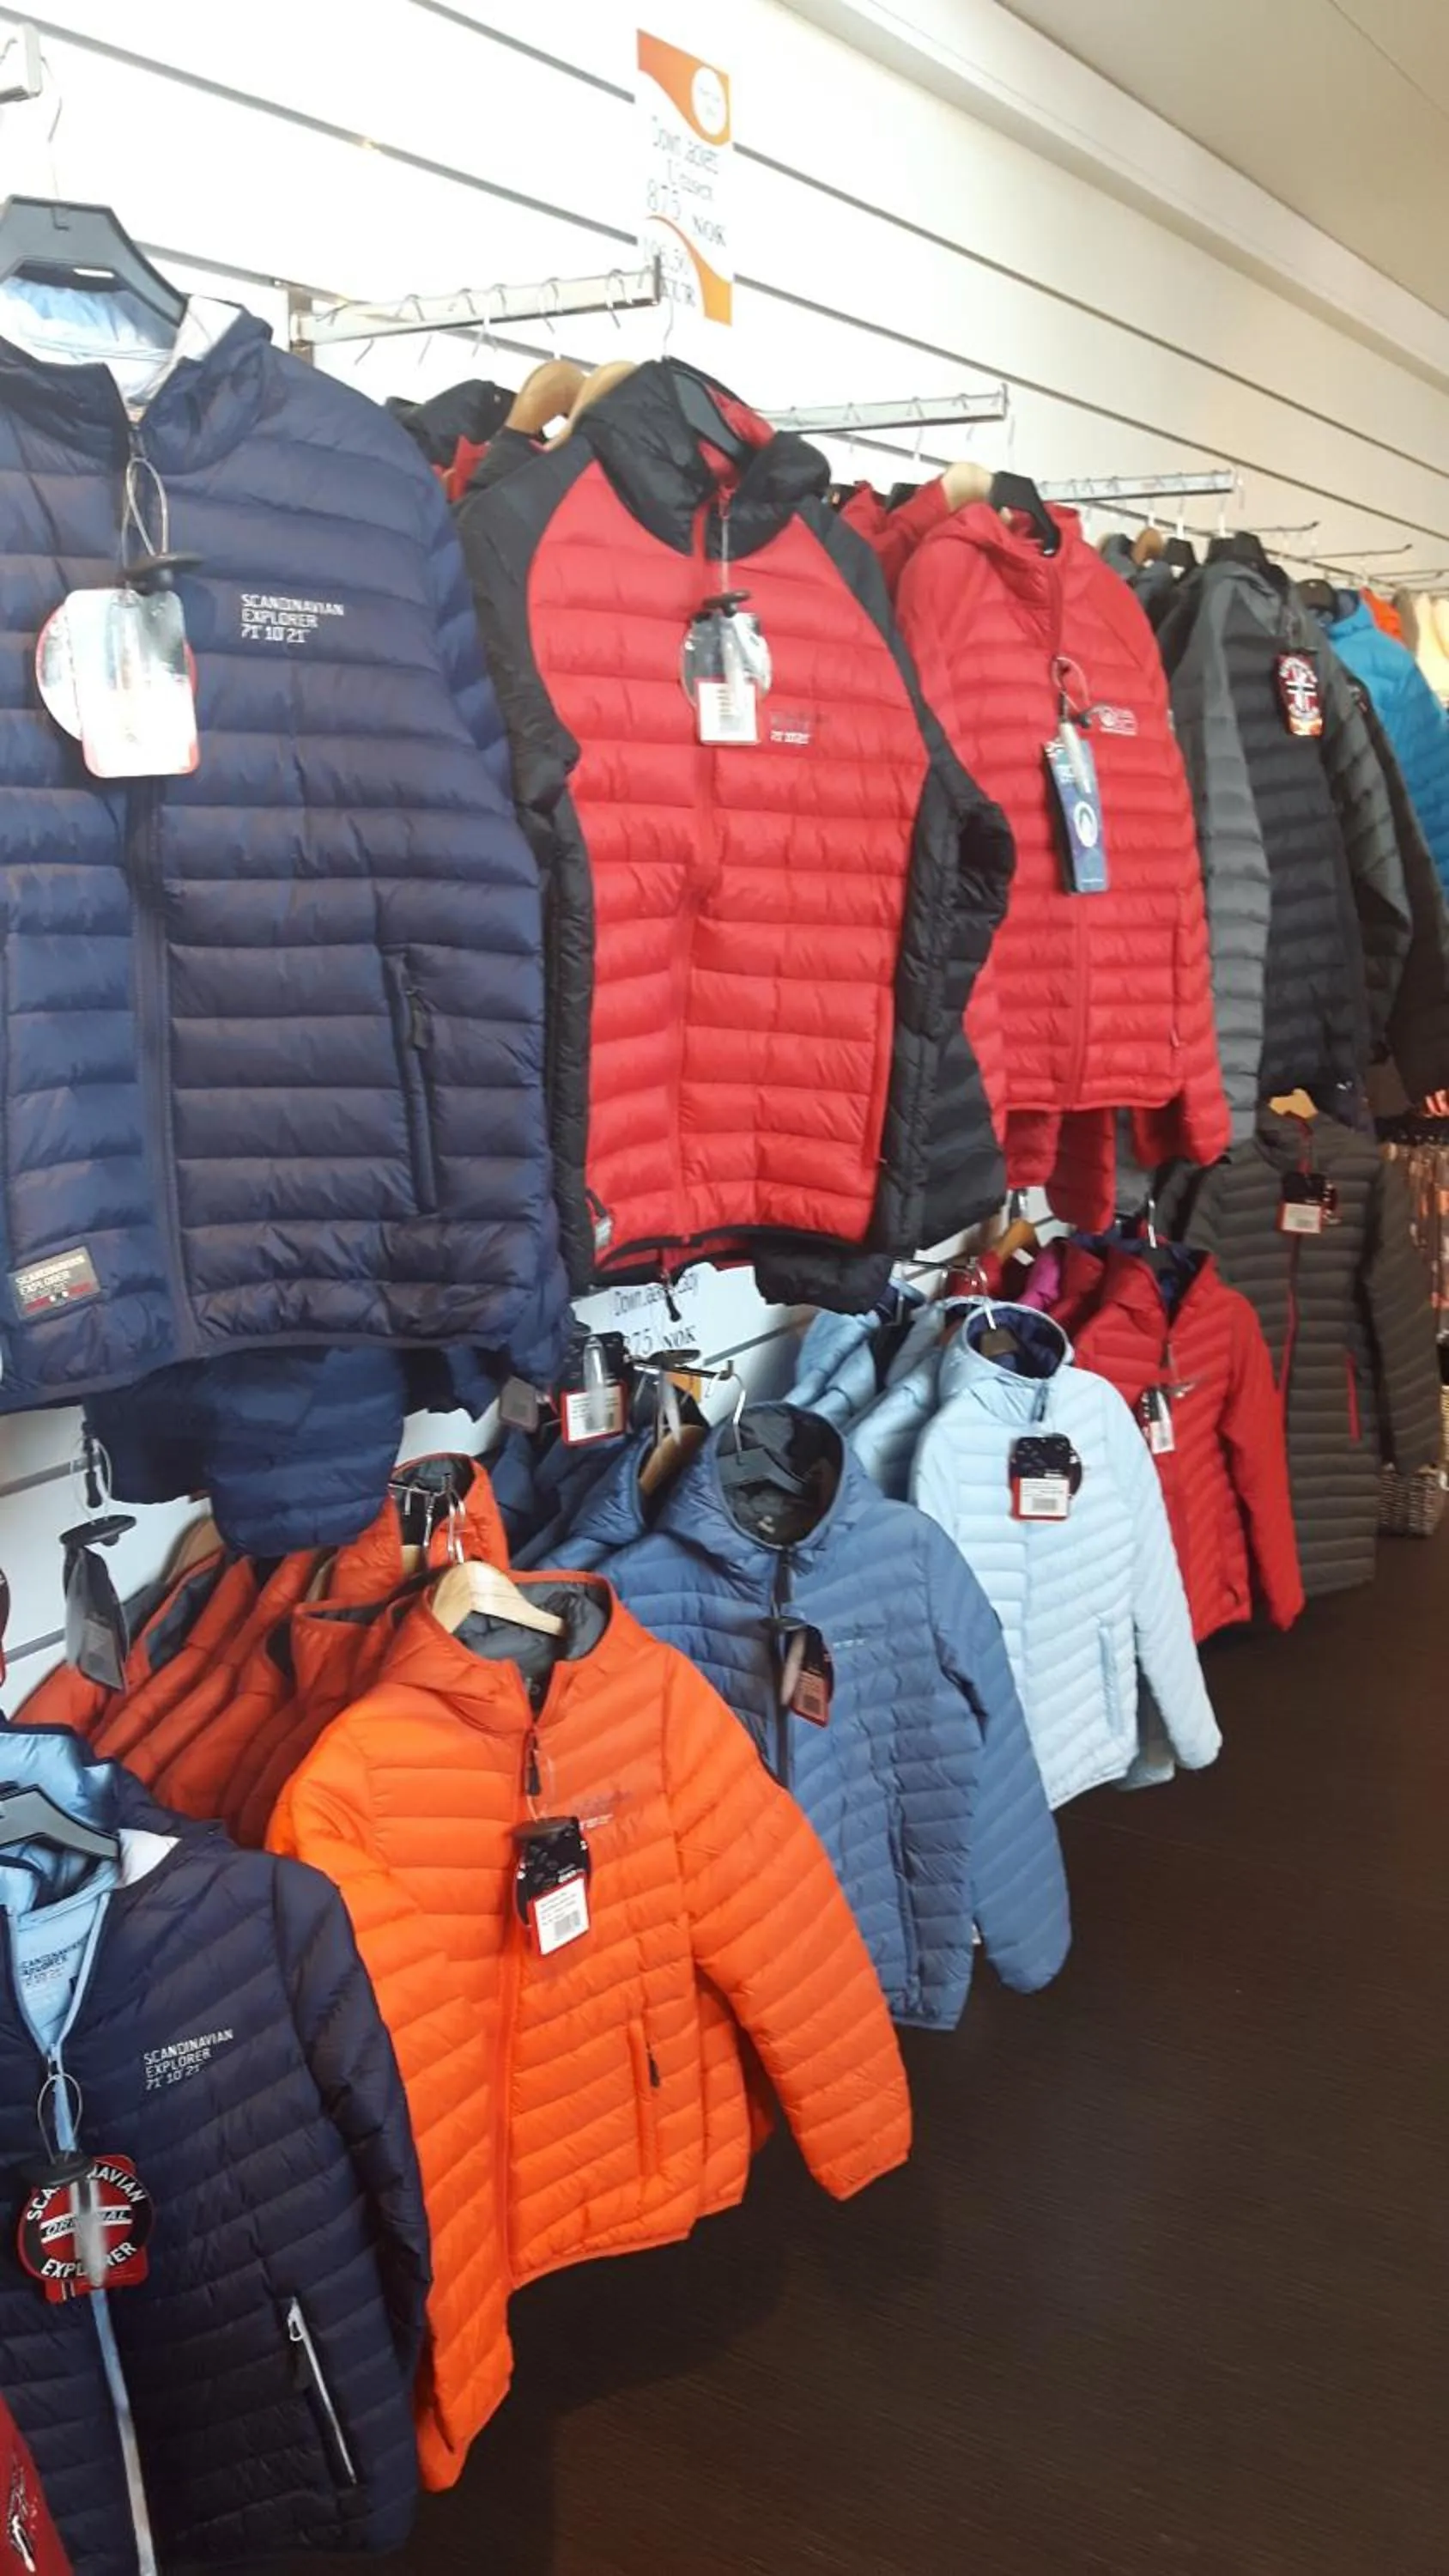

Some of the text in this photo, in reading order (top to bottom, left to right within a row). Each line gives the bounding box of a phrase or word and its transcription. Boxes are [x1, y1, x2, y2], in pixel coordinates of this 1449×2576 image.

[241, 593, 344, 616] SCANDINAVIAN
[241, 608, 318, 629] EXPLORER
[143, 2028, 233, 2065] SCANDINAVIAN
[145, 2048, 212, 2079] EXPLORER
[40, 2241, 137, 2279] EXPLER
